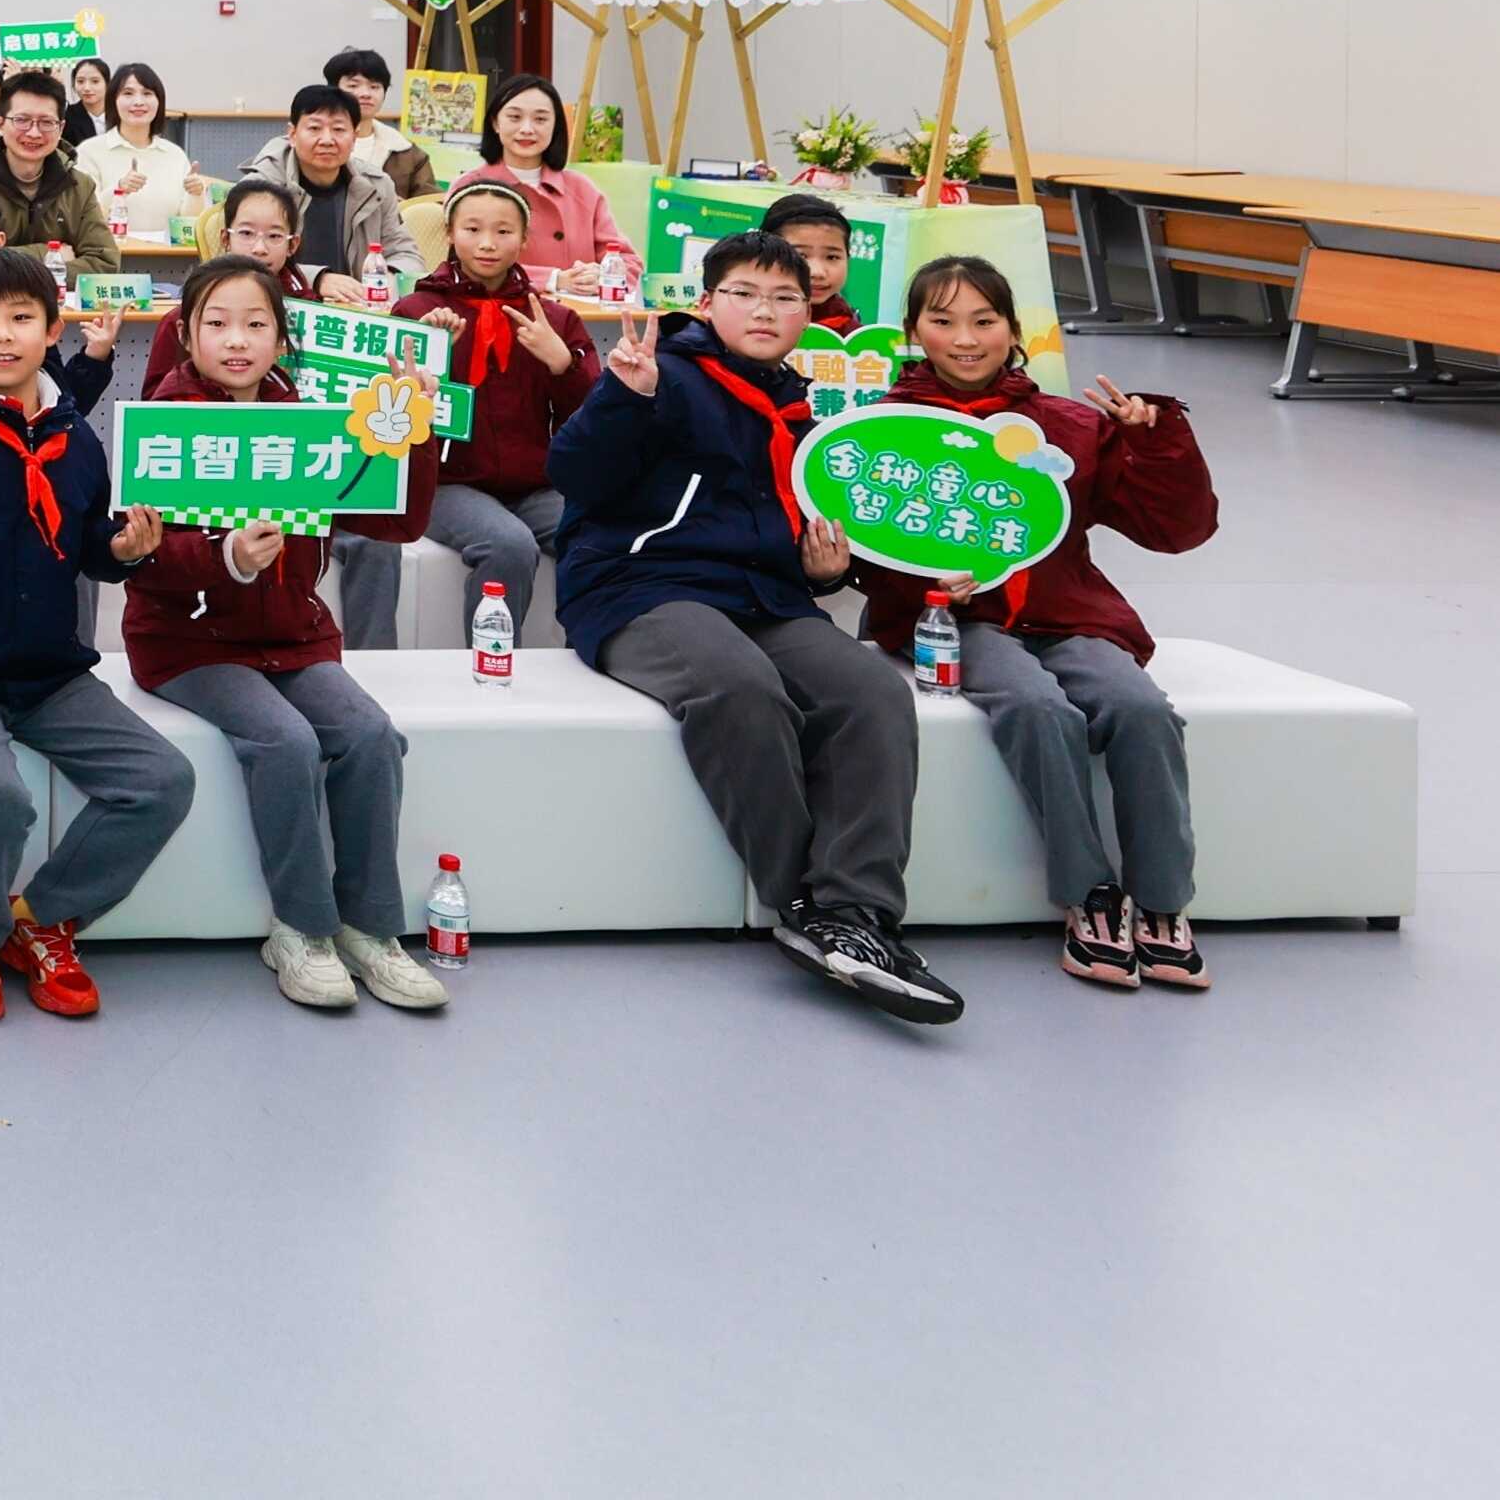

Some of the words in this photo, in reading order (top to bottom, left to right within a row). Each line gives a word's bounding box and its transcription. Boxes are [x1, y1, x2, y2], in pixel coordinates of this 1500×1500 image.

[4, 30, 80, 51] 启智育才
[96, 286, 136, 299] 张昌帆
[663, 285, 696, 298] 杨柳
[134, 435, 352, 481] 启智育才
[826, 441, 1022, 509] 金种童心
[850, 484, 1028, 555] 智启未来
